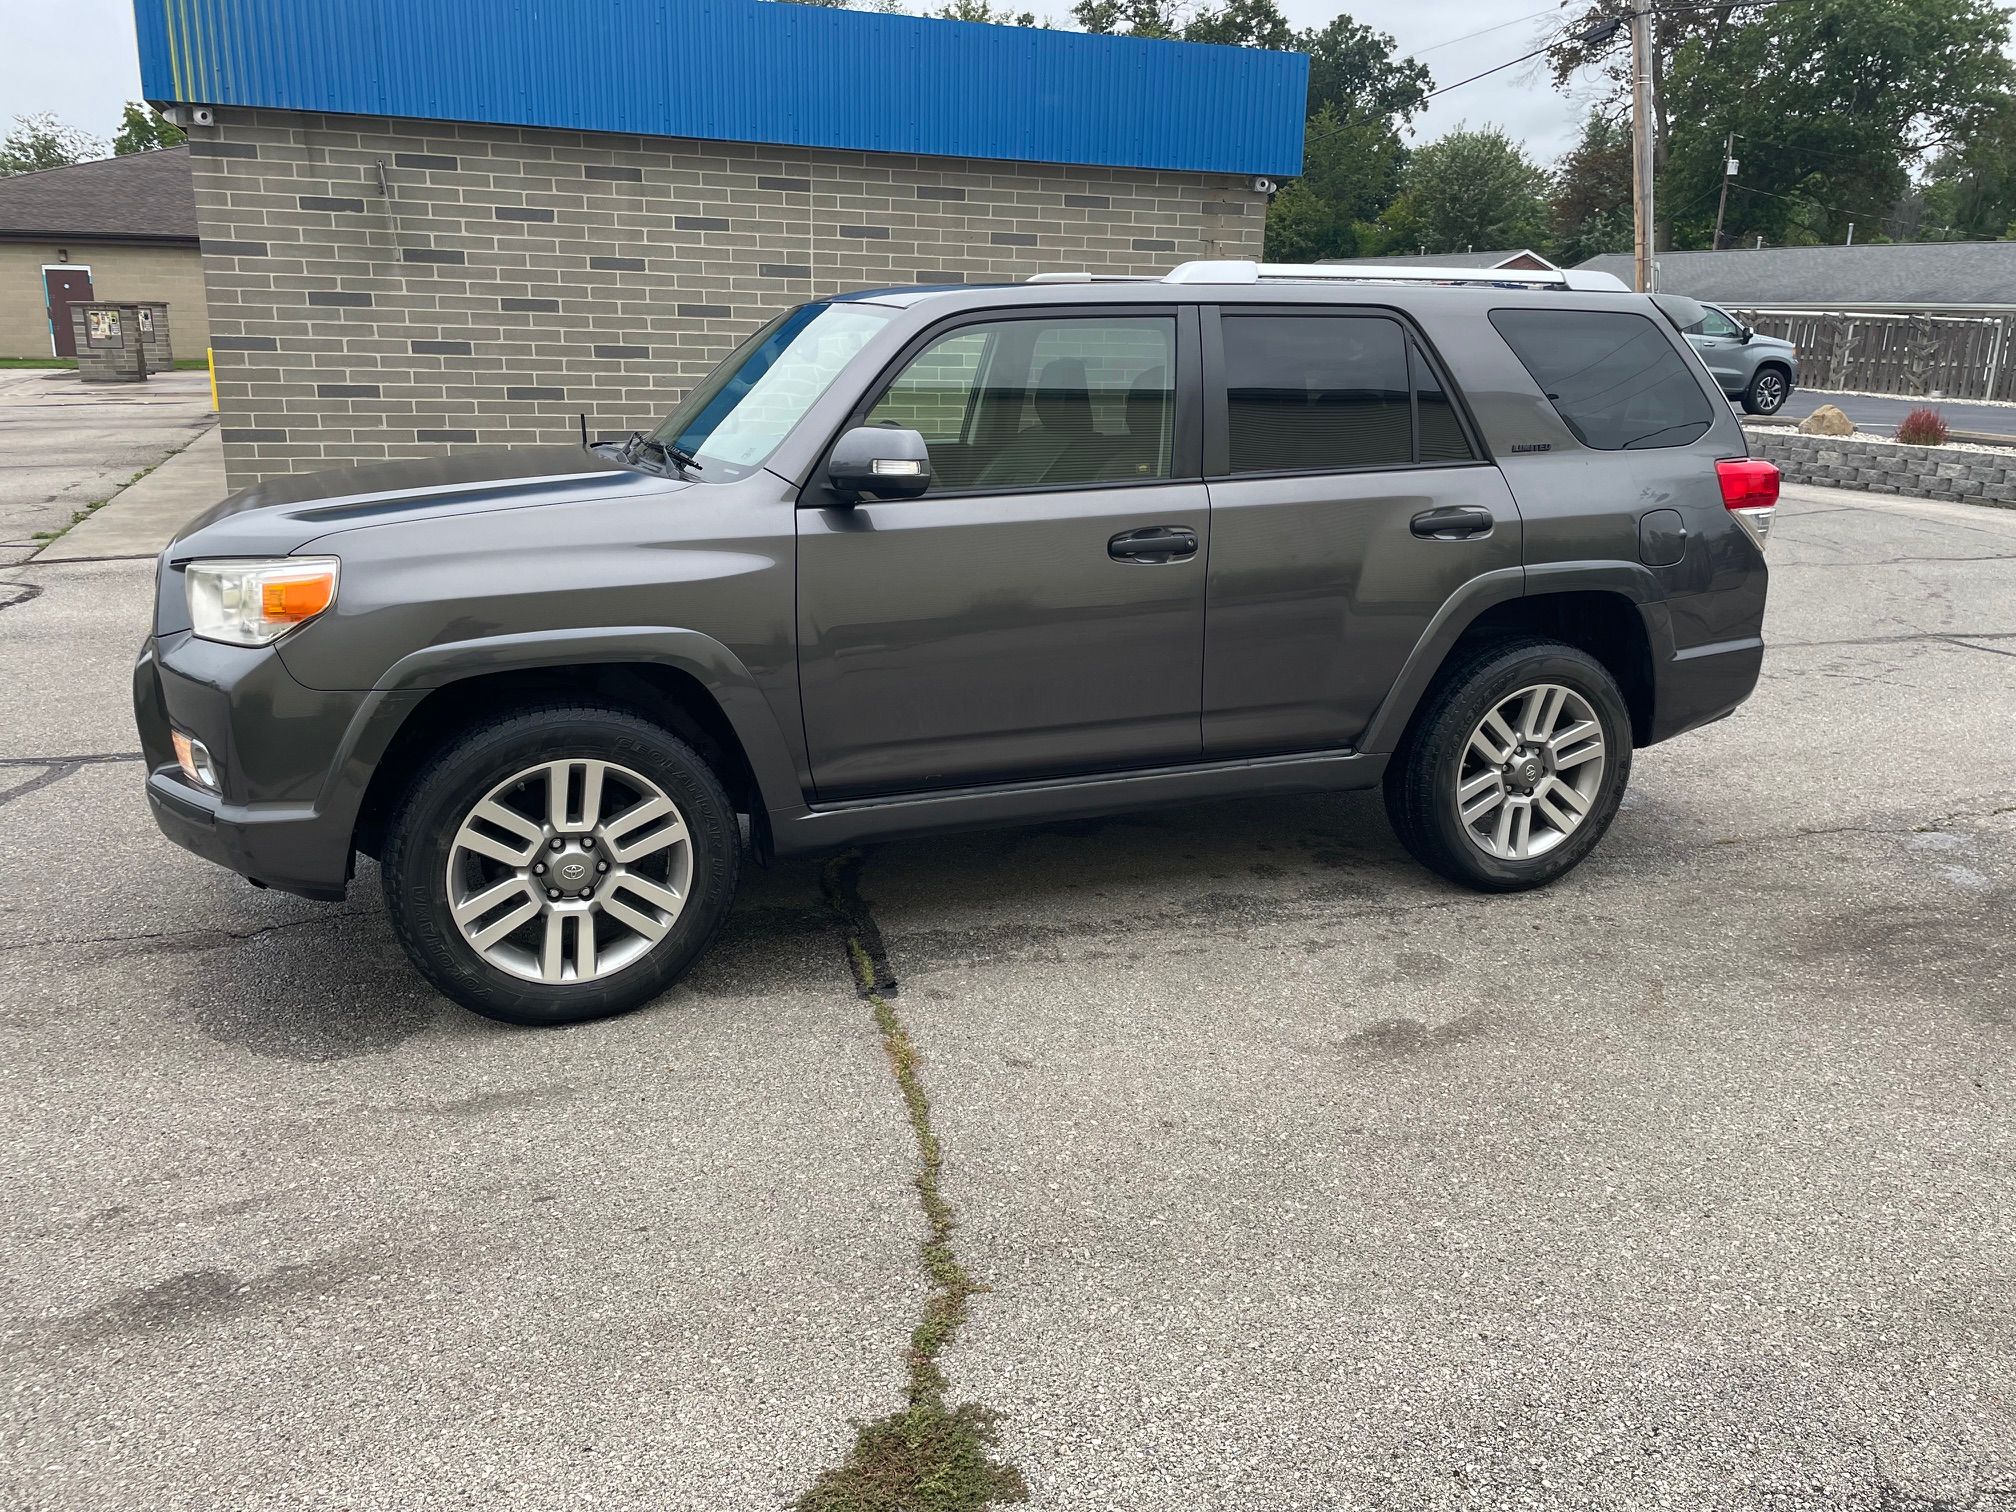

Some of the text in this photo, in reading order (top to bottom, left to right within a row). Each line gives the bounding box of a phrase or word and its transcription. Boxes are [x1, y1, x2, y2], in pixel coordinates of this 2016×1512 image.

[1511, 443, 1552, 453] LIMITED
[615, 734, 722, 848] GEOLANDAR
[412, 885, 493, 1001] YOKOHAMA
